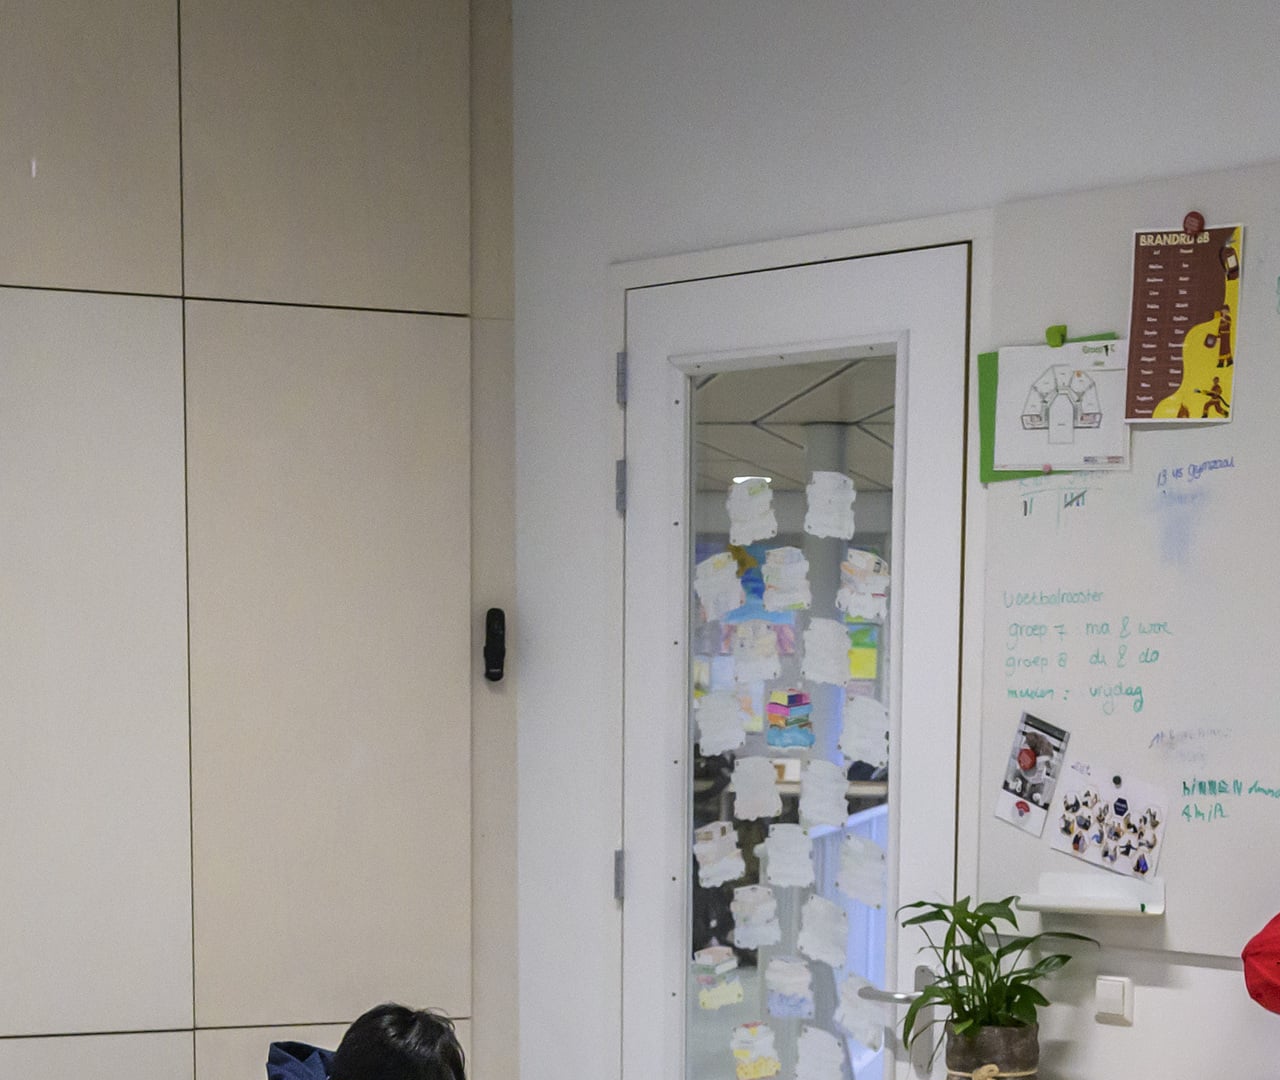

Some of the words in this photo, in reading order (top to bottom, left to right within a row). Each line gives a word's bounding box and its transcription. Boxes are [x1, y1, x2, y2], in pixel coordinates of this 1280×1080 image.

[1007, 622, 1048, 650] groep
[1085, 623, 1110, 634] ma
[1005, 655, 1048, 677] groep
[1058, 653, 1068, 668] 8
[1138, 648, 1160, 664] do
